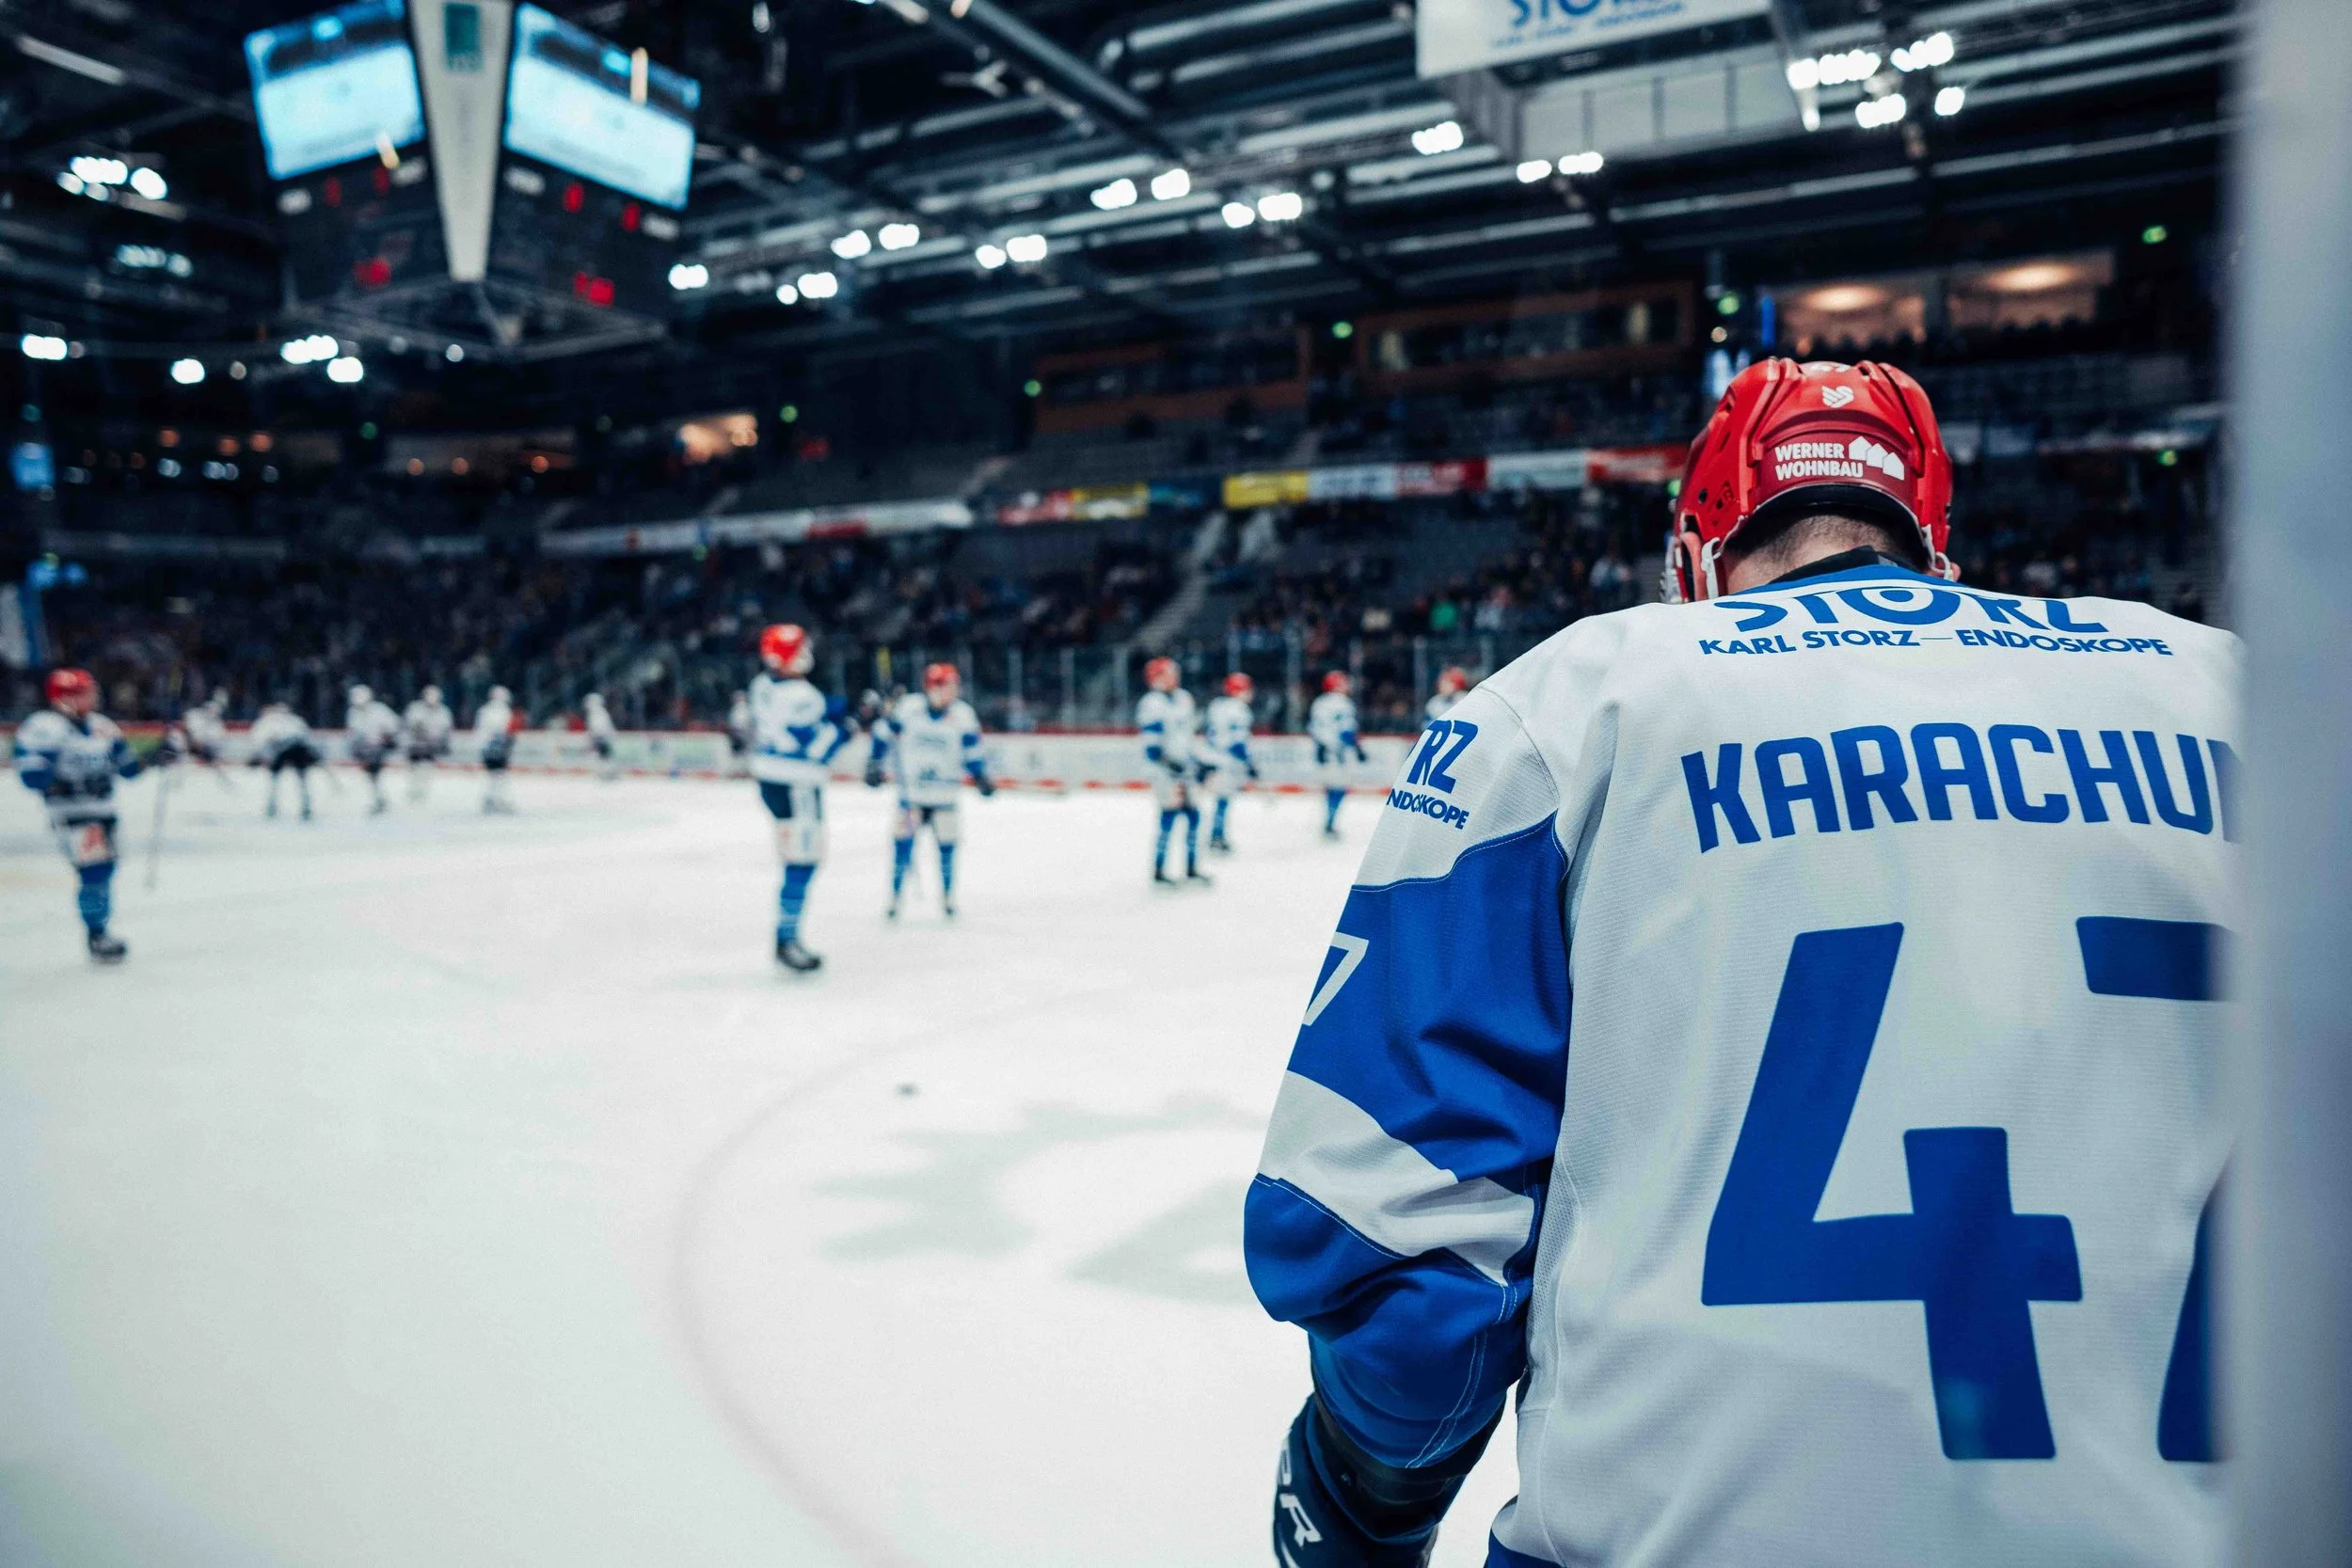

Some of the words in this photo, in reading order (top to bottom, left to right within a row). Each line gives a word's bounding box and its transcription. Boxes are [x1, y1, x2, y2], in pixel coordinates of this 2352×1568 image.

[1774, 442, 1845, 462] WERNER
[1775, 460, 1864, 481] WOHNBAU
[1698, 635, 1797, 655] KARL
[1800, 629, 1921, 649] STORZ
[1955, 629, 2174, 656] ENDOSKOPE
[1406, 719, 1479, 795] RZ
